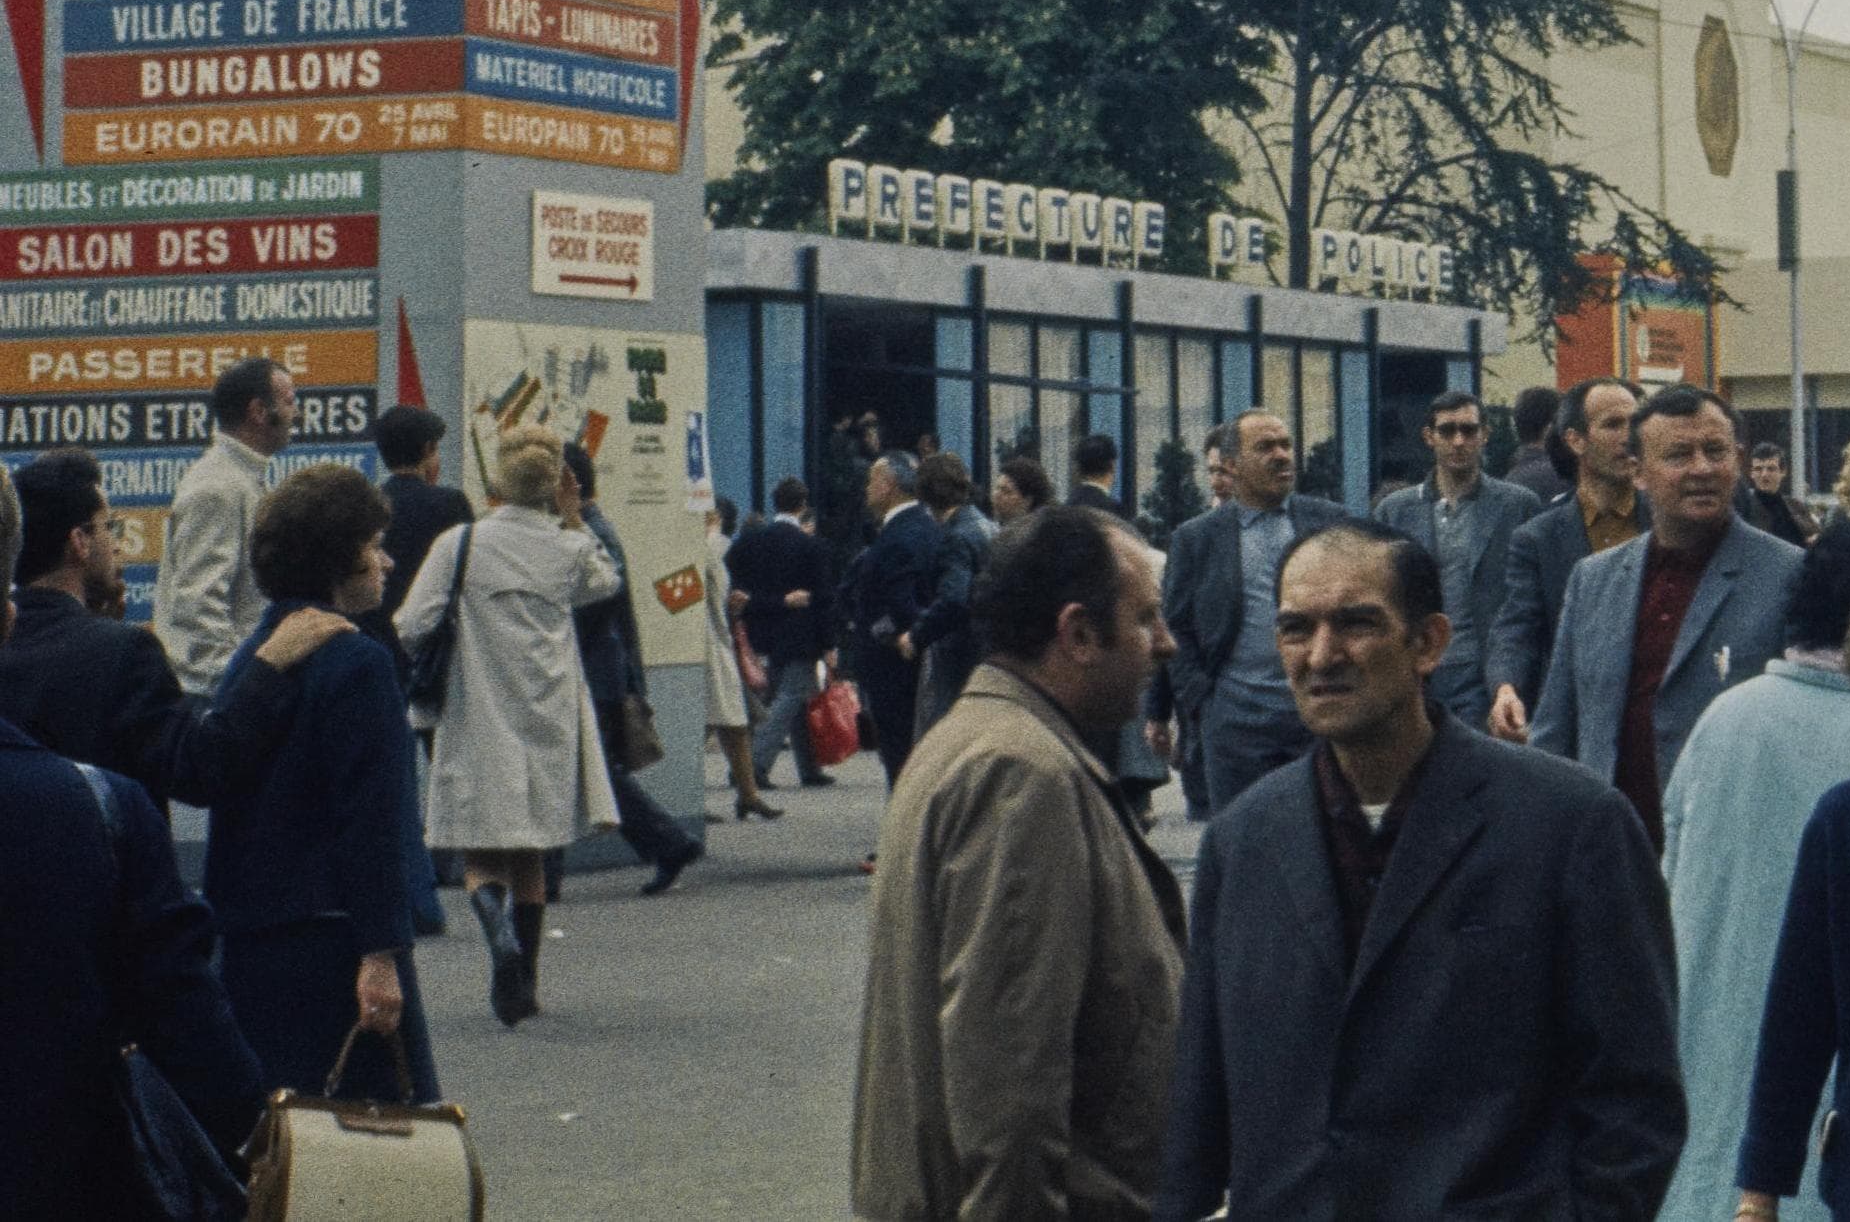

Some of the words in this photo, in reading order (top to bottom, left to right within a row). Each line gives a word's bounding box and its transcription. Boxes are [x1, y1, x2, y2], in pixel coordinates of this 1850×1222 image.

[112, 0, 224, 43] VILLAGE
[561, 7, 659, 56] LUMINAIRES
[141, 49, 382, 99] BUNGALOWS
[476, 53, 568, 94] MATERIEL
[572, 68, 667, 109] HORTICOLE
[314, 111, 363, 143] 70
[597, 125, 625, 156] 70
[281, 170, 363, 202] JARDIN
[18, 231, 134, 274] SALON
[158, 226, 231, 268] DES
[251, 222, 338, 264] VINS
[843, 166, 1164, 250] PREFECTURE
[1221, 219, 1265, 263] DE
[1322, 233, 1454, 289] POLICE
[104, 284, 227, 326] CHAUFFAGE
[236, 280, 374, 320] DOMESTIQUE
[29, 343, 310, 383] PASSEREE
